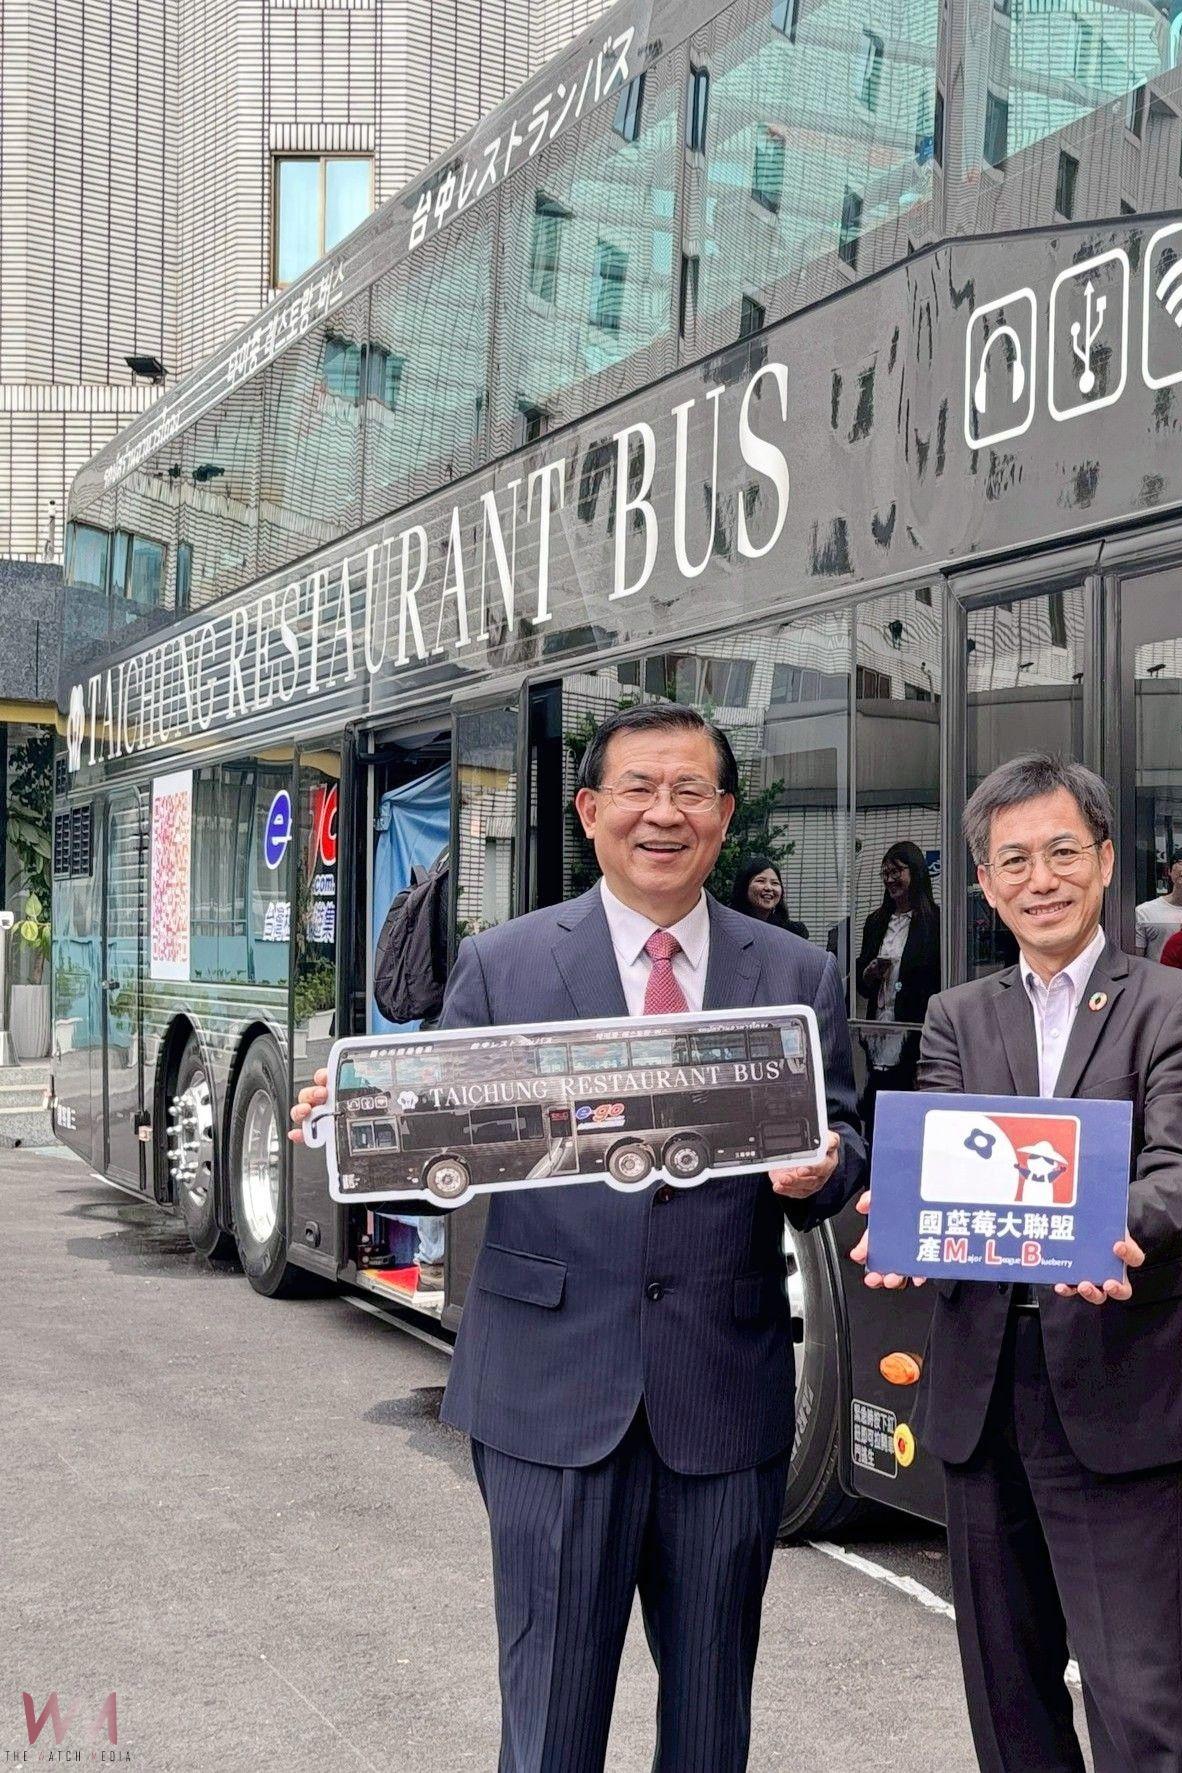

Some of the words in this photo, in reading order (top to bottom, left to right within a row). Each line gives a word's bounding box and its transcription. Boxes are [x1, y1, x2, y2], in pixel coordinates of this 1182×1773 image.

[409, 27, 634, 250] 台中レストランバス
[88, 624, 218, 766] TAICHUNG
[224, 458, 566, 719] RESTAURANT
[608, 363, 790, 601] BUS
[429, 1082, 547, 1108] TAICHUNG
[560, 1066, 720, 1099] RESTAURANT
[734, 1061, 779, 1083] BUS
